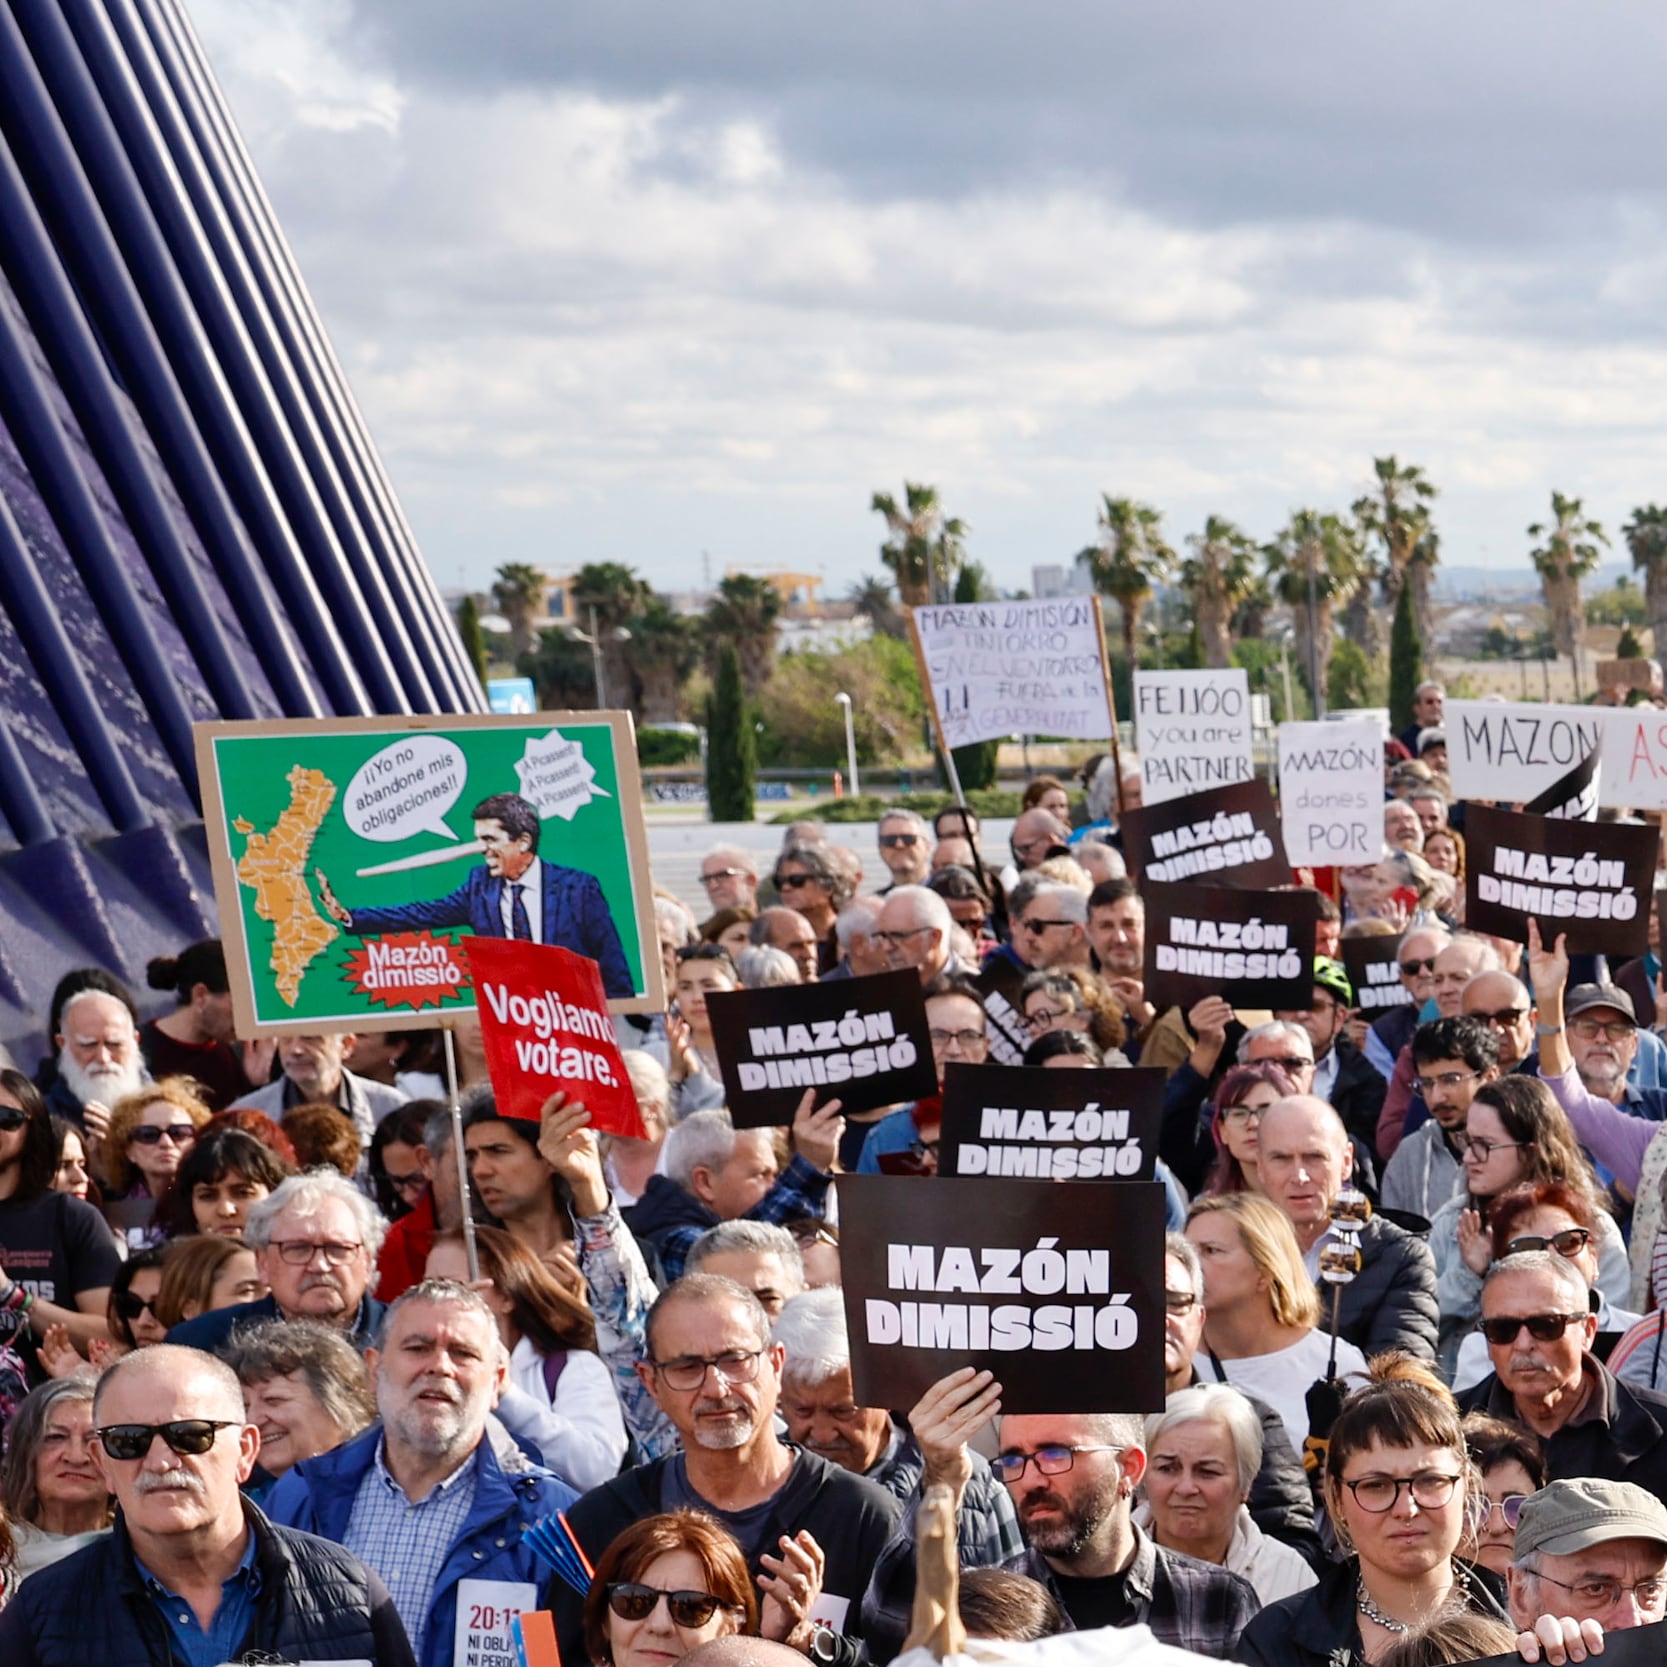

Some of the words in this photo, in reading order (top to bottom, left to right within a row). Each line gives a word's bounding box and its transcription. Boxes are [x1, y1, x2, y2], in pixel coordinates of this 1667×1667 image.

[1139, 680, 1243, 717] FEIJÓO
[397, 748, 414, 765] no
[1148, 728, 1197, 750] you
[1203, 727, 1243, 744] are
[356, 767, 425, 811] abandone
[429, 752, 454, 775] mis
[1145, 757, 1251, 785] PARTNER
[1296, 790, 1368, 809] dones
[1151, 811, 1255, 858] MAZÓN
[1308, 823, 1369, 853] POR
[1146, 831, 1274, 883] DIMISSIÓ
[1493, 846, 1625, 888] MAZÓN
[1478, 873, 1638, 922] DIMISSIÓ
[1170, 914, 1288, 950] MAZÓN
[367, 942, 448, 967] Mazón
[1155, 938, 1301, 980] DIMISSIÓ
[362, 962, 461, 989] dimissió
[748, 1010, 896, 1058] MAZÓN
[515, 1039, 619, 1088] votare.
[737, 1030, 918, 1093] DIMISSIÓ
[980, 1102, 1131, 1143] MAZÓN
[957, 1136, 1143, 1180] DIMISSIÓ
[887, 1237, 1110, 1296] MAZÓN
[866, 1294, 1138, 1352] DIMISSIÓ
[466, 1653, 479, 1666] NI
[468, 1636, 480, 1649] NI
